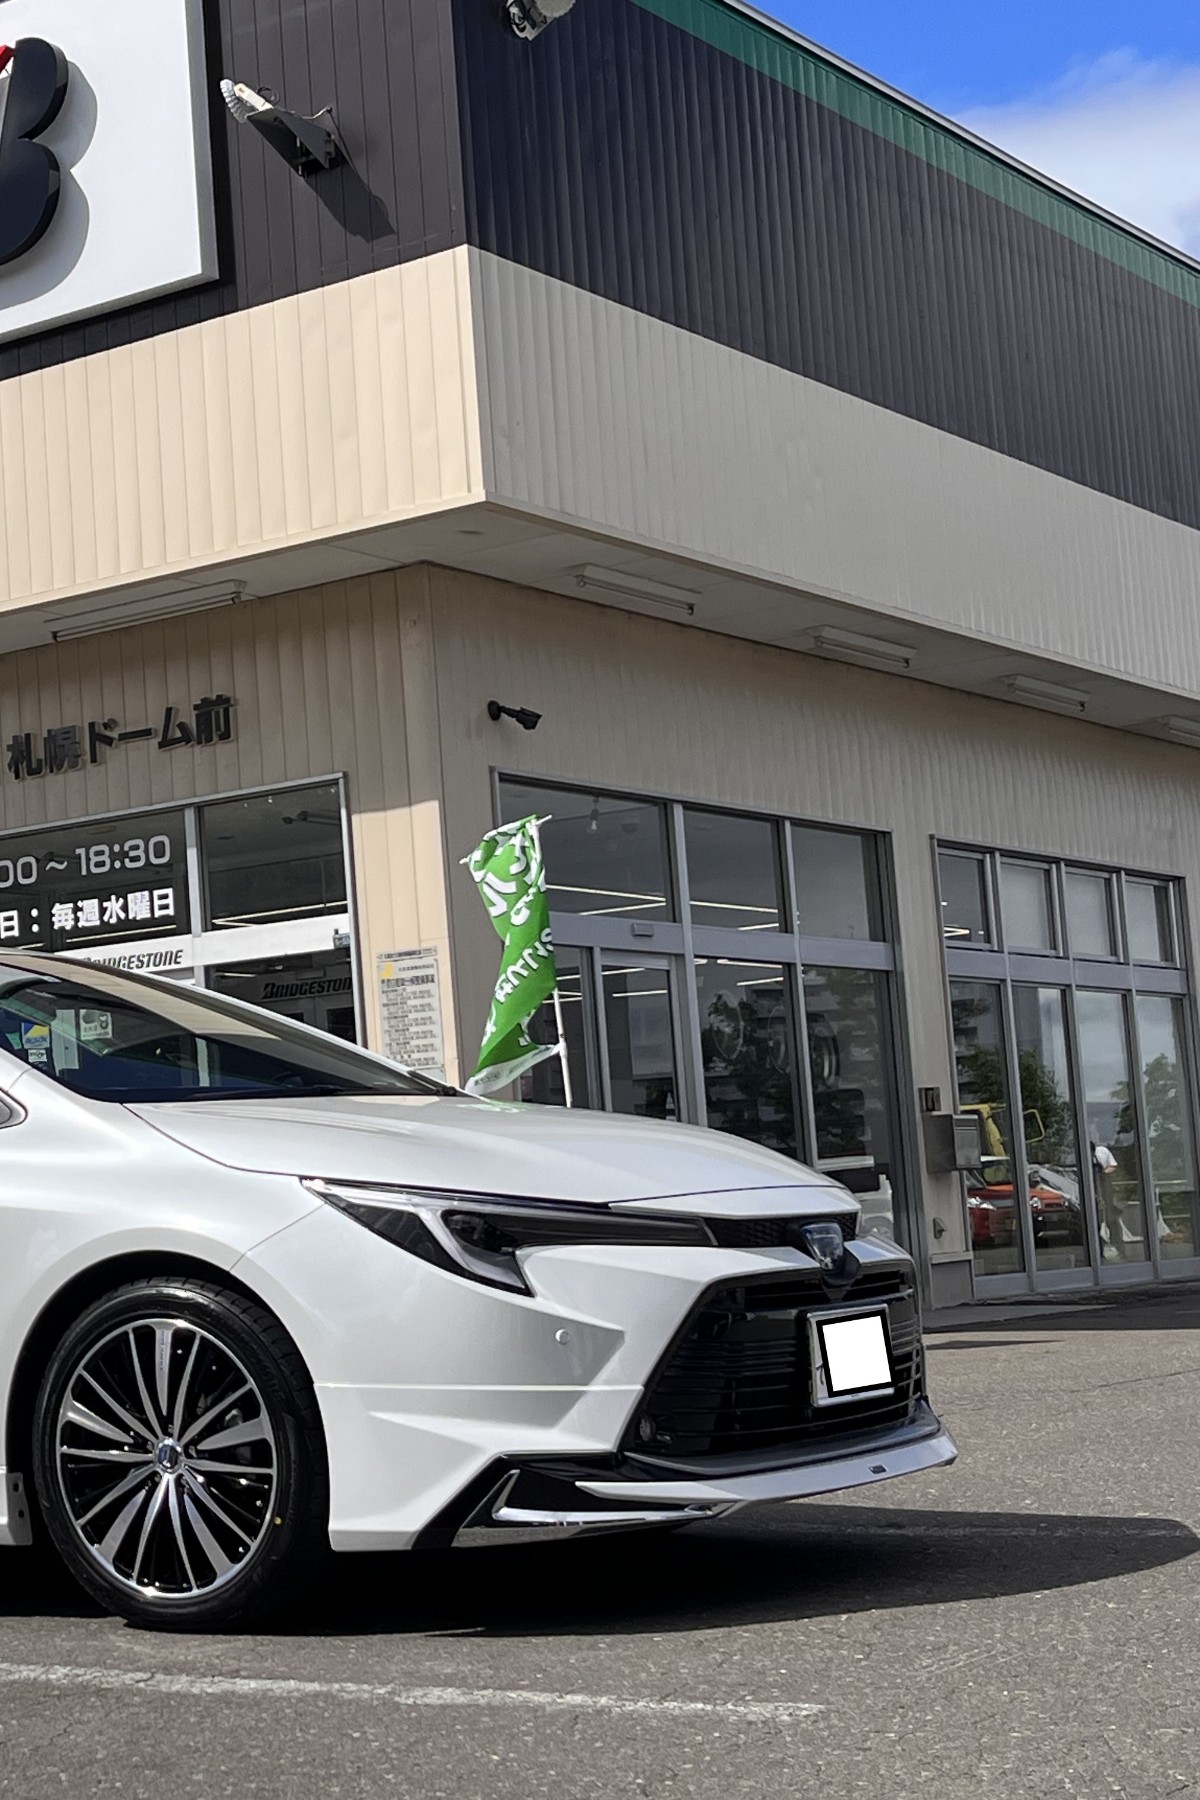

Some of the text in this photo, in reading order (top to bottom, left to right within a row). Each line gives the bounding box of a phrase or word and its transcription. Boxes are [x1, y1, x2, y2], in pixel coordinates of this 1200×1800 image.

[6, 694, 233, 780] 札幌ドーム前
